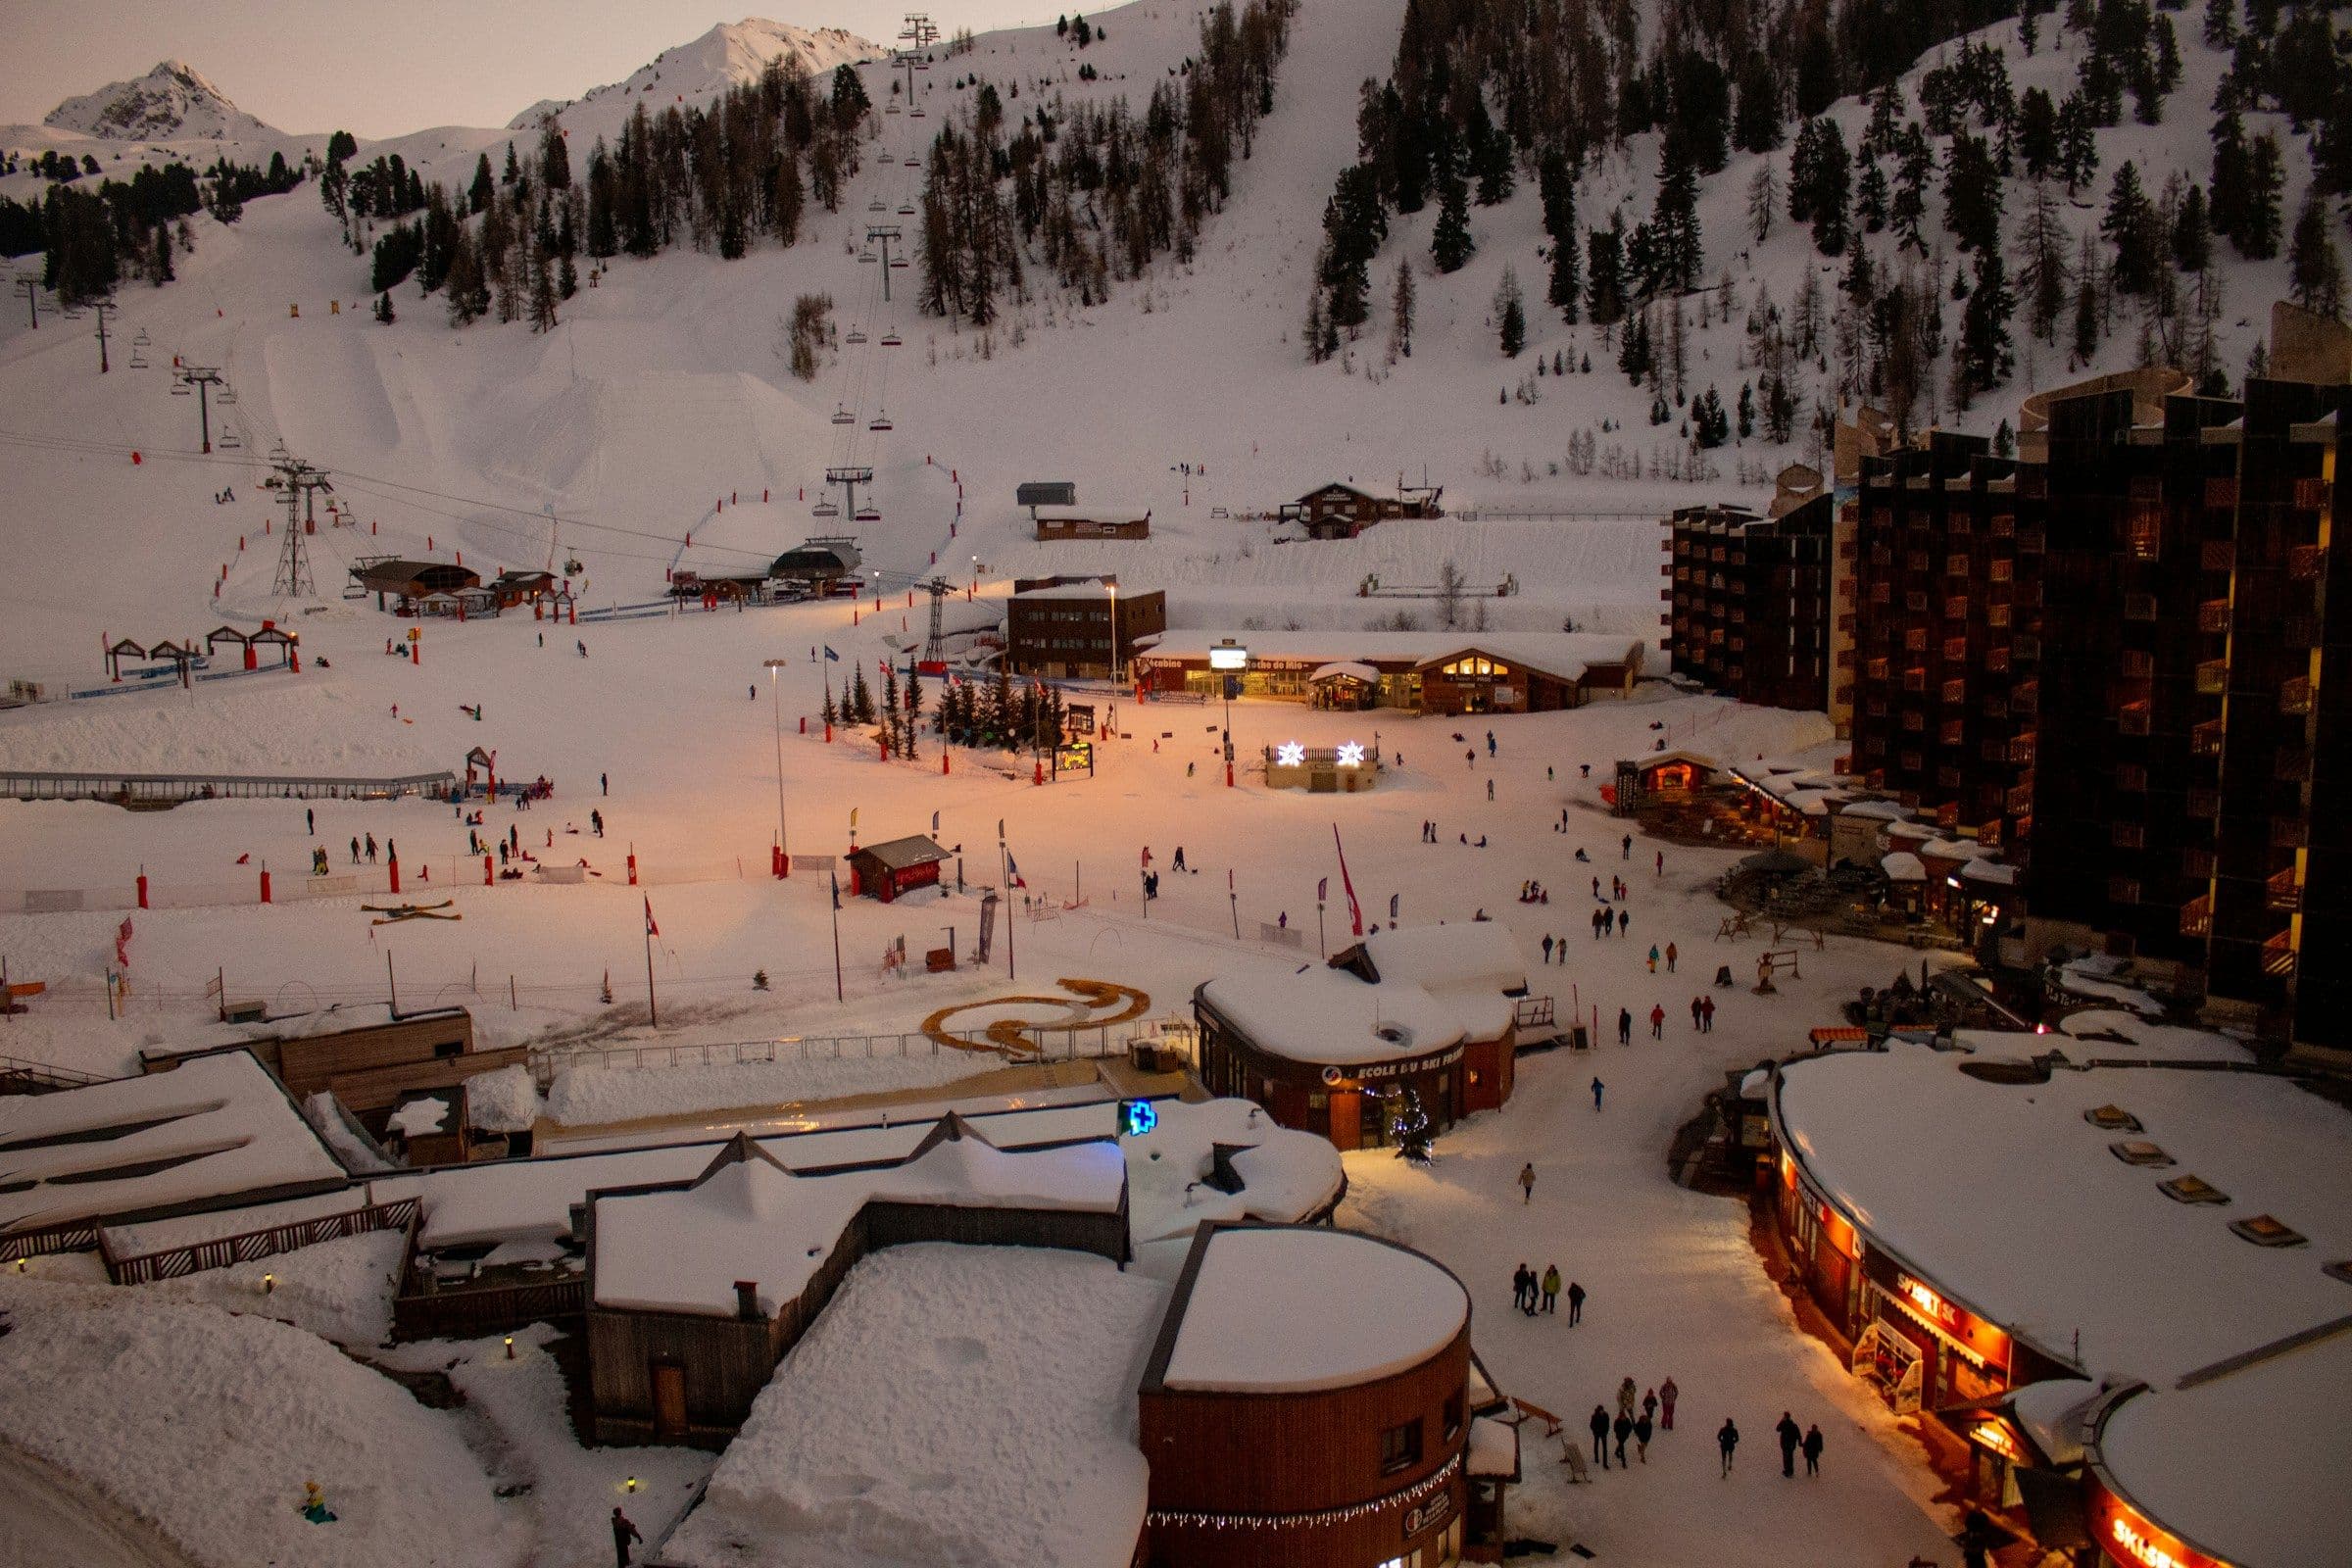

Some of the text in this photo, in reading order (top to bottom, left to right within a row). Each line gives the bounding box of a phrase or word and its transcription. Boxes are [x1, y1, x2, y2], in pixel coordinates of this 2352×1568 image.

[1357, 1065, 1396, 1079] ECOLE
[1399, 1060, 1418, 1074] DU
[1422, 1057, 1441, 1071] SKI
